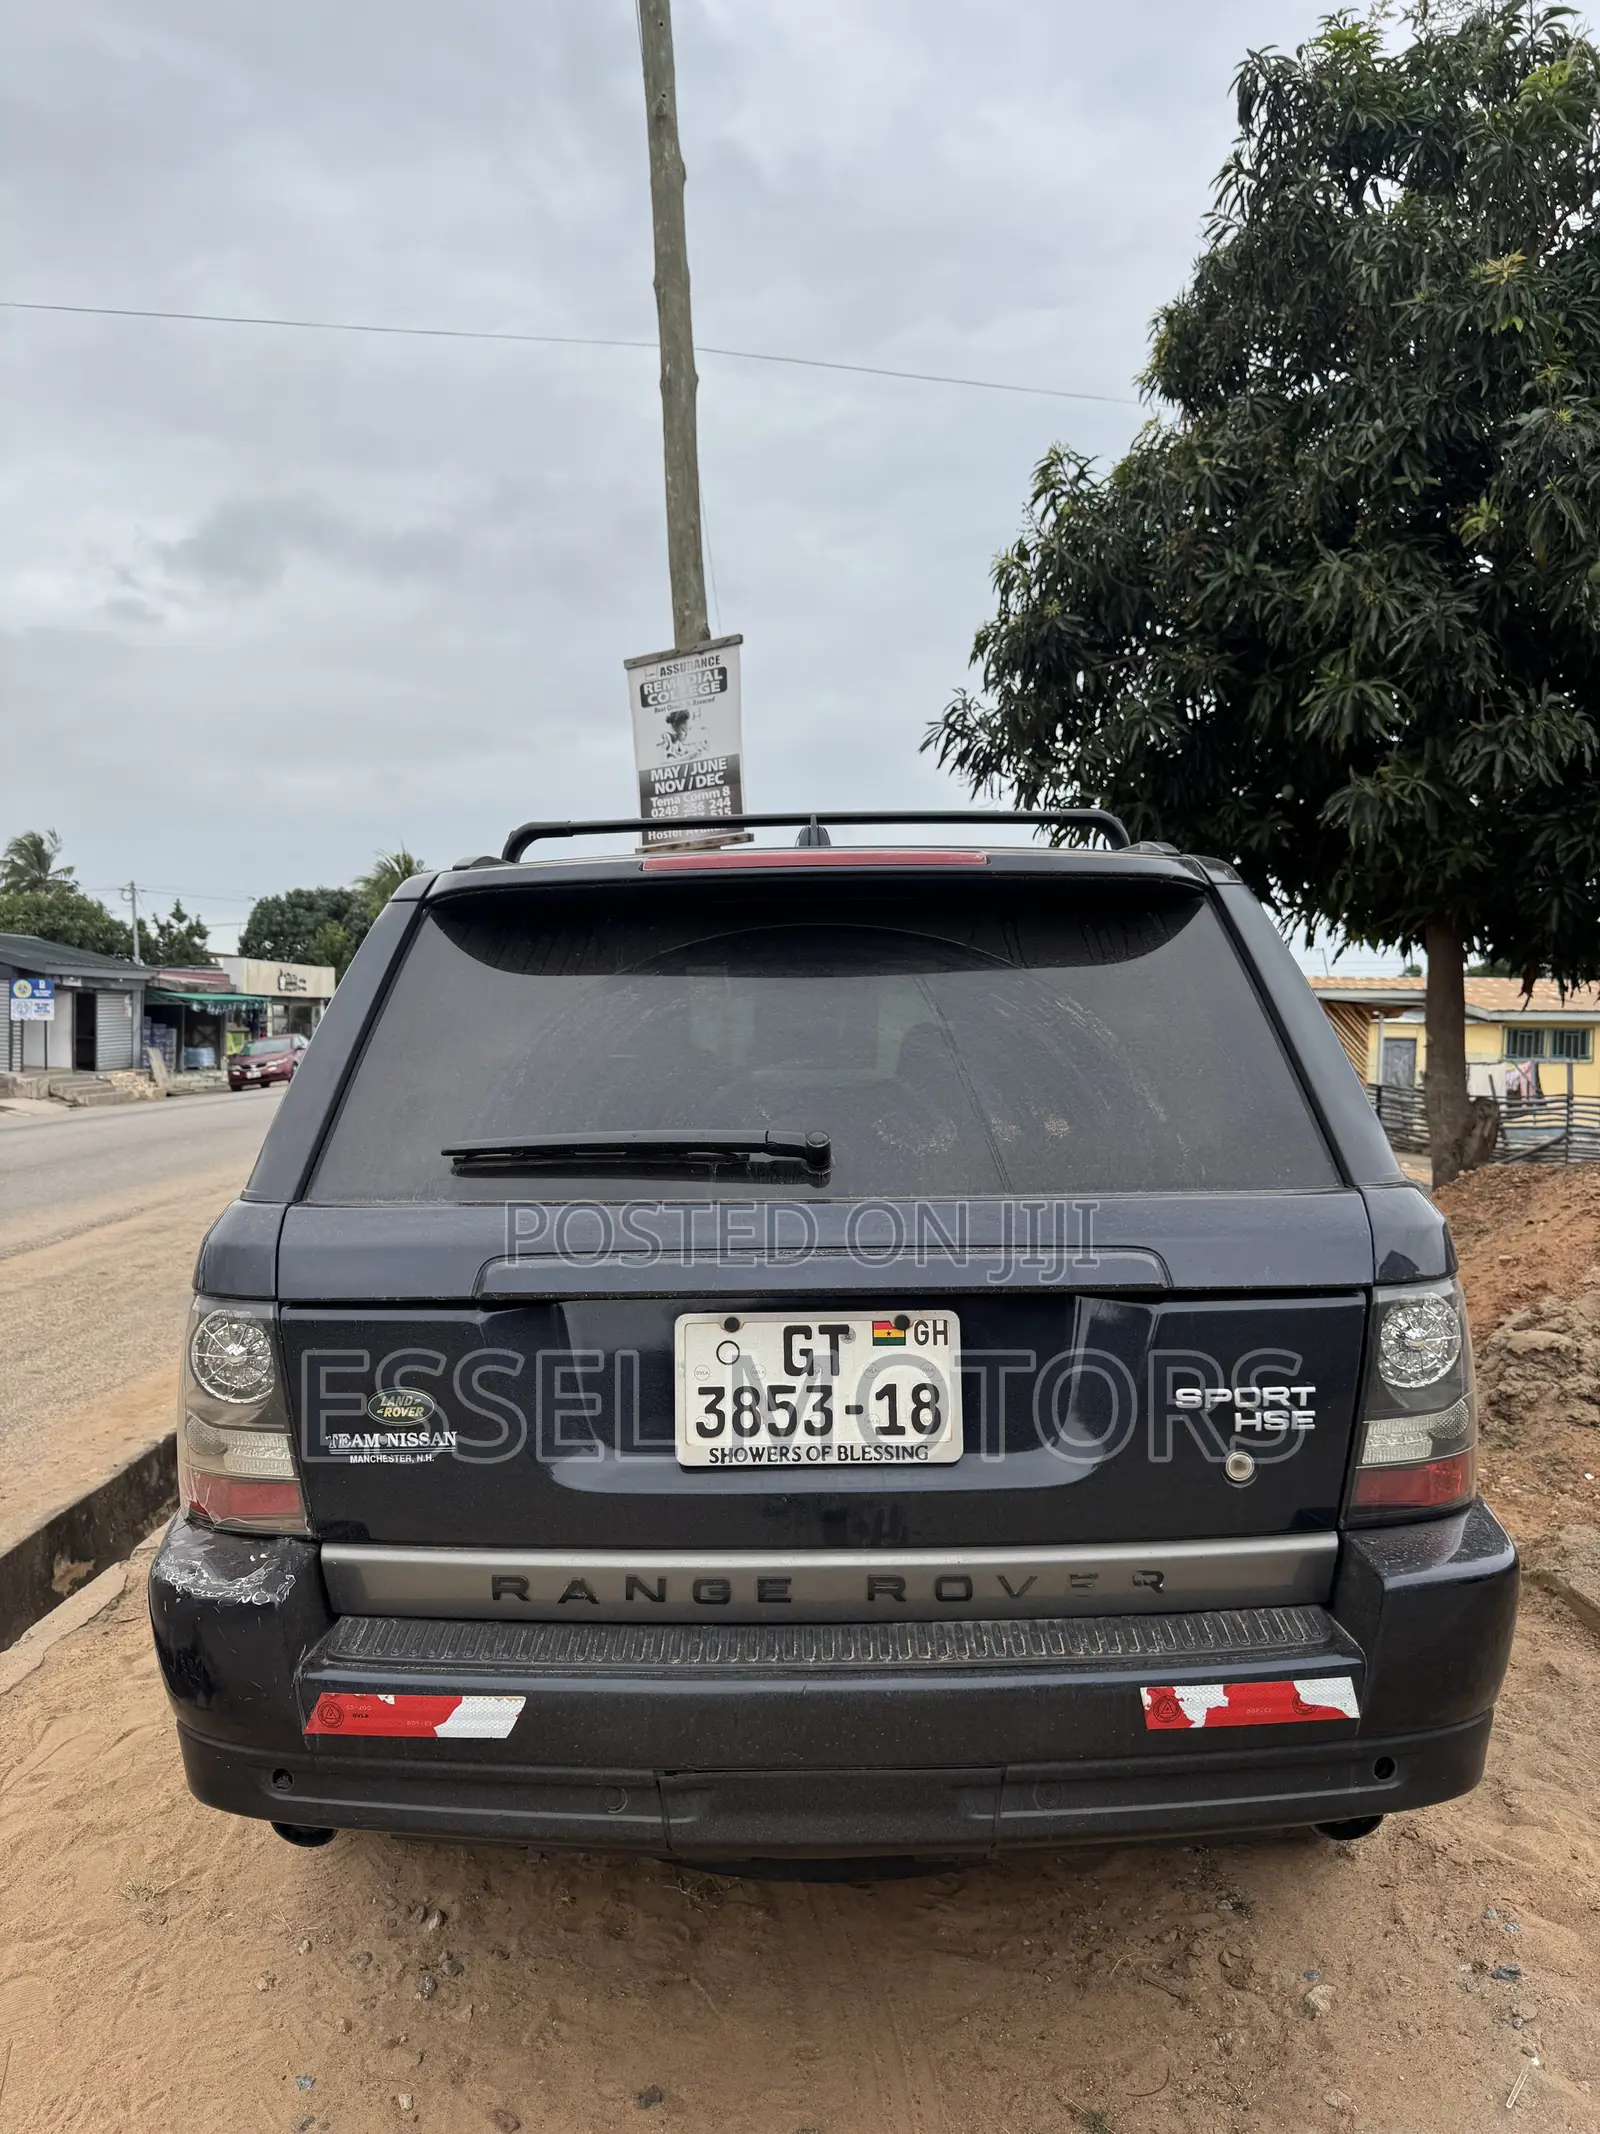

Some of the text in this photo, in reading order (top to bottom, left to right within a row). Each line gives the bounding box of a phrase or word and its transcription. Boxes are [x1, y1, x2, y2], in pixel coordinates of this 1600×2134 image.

[643, 669, 723, 695] REMDIAL
[650, 765, 680, 782] MAY
[690, 757, 728, 776] JUNE
[654, 778, 686, 795] NOV
[695, 772, 724, 788] DEC
[650, 785, 731, 808] Tema Comm 8
[651, 805, 679, 818] 0249
[708, 797, 731, 809] 244
[913, 1320, 949, 1346] GH
[783, 1325, 850, 1377] GT
[380, 1396, 413, 1406] LAND
[1175, 1386, 1316, 1409] SPORT
[384, 1407, 424, 1417] ROVER
[696, 1383, 942, 1438] 3853-18
[1235, 1410, 1316, 1432] HSE
[326, 1431, 457, 1449] TEAM NISSAN
[350, 1453, 435, 1464] MANCHESTER, N.H.
[709, 1445, 929, 1465] SHOWERS OF BLESSING
[491, 1569, 1165, 1605] RANGE ROVER
